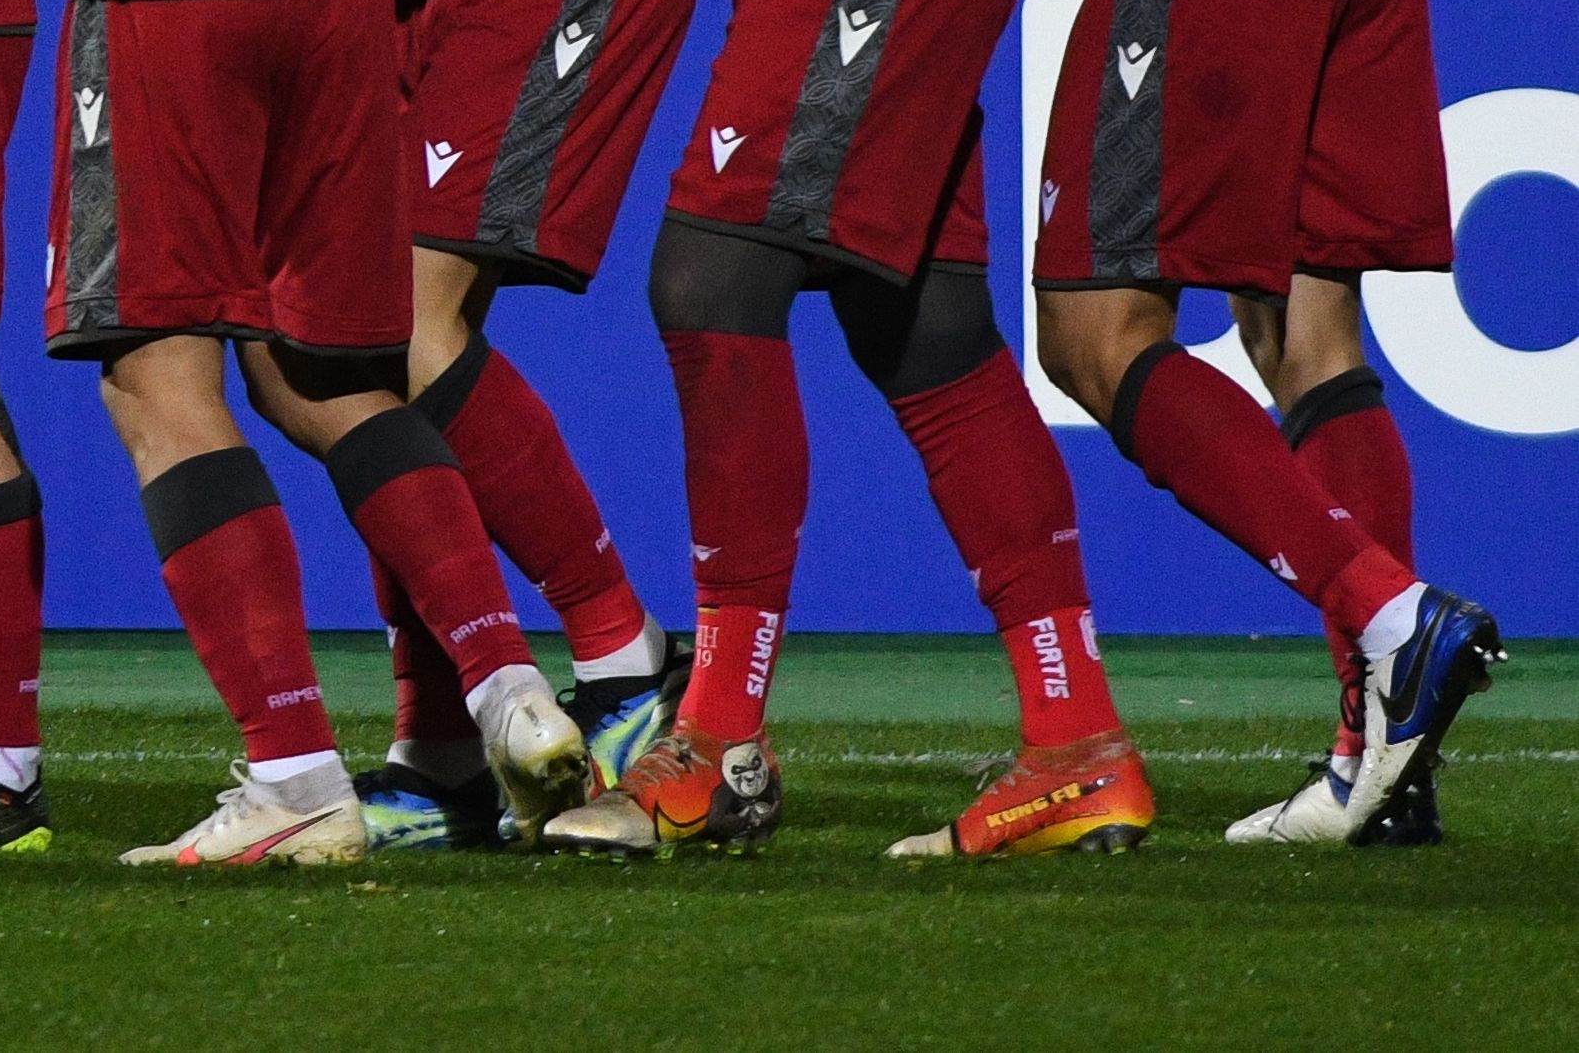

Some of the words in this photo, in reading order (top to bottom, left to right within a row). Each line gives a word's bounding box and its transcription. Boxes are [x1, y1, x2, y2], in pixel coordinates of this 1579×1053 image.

[746, 610, 780, 699] FORTIS
[1027, 616, 1070, 699] FORTIS
[985, 797, 1050, 828] KUNG
